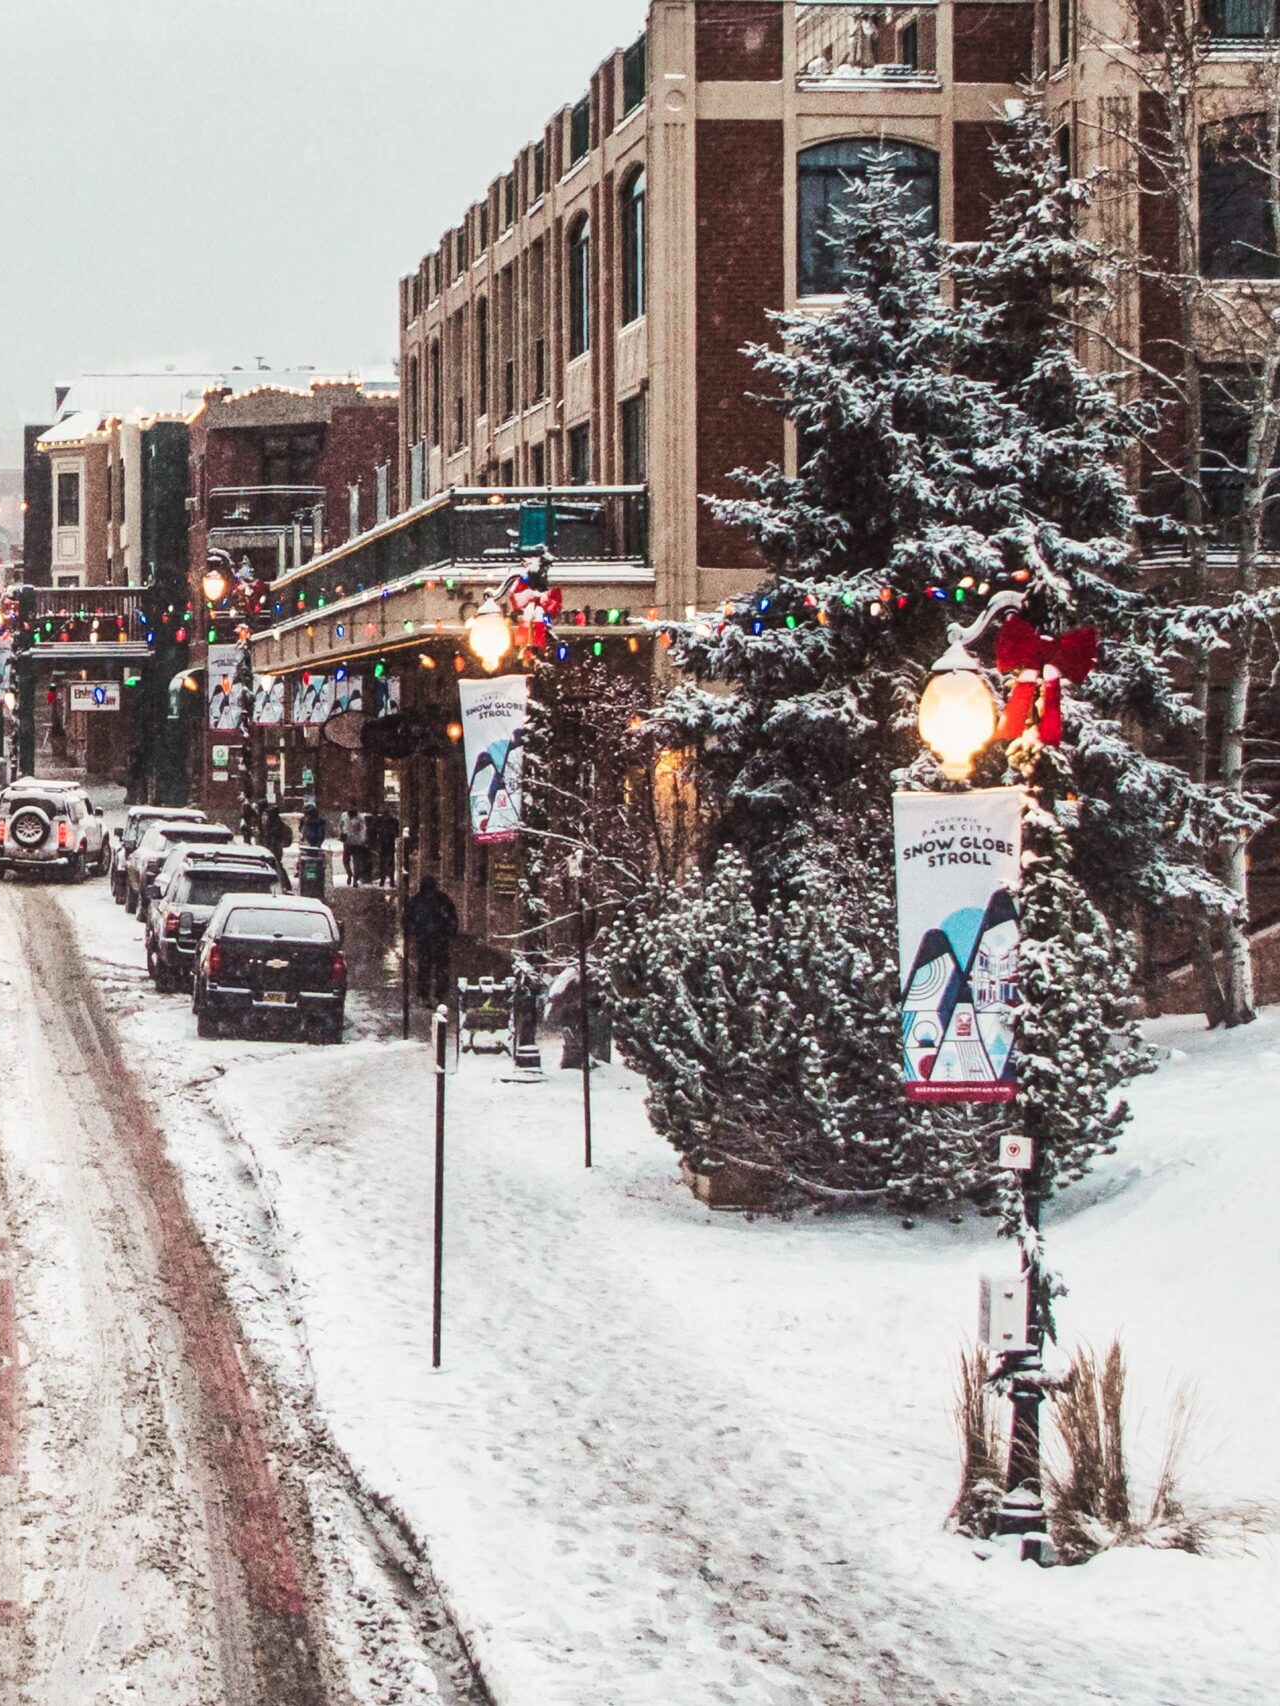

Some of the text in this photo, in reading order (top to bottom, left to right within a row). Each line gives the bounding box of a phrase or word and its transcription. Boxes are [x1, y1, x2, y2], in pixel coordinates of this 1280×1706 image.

[465, 702, 524, 717] SNOW GLOBE
[479, 710, 511, 720] STROLL
[922, 824, 992, 837] PARK CITY
[903, 837, 1013, 860] SNOW GLOBE
[928, 851, 991, 867] STROLL
